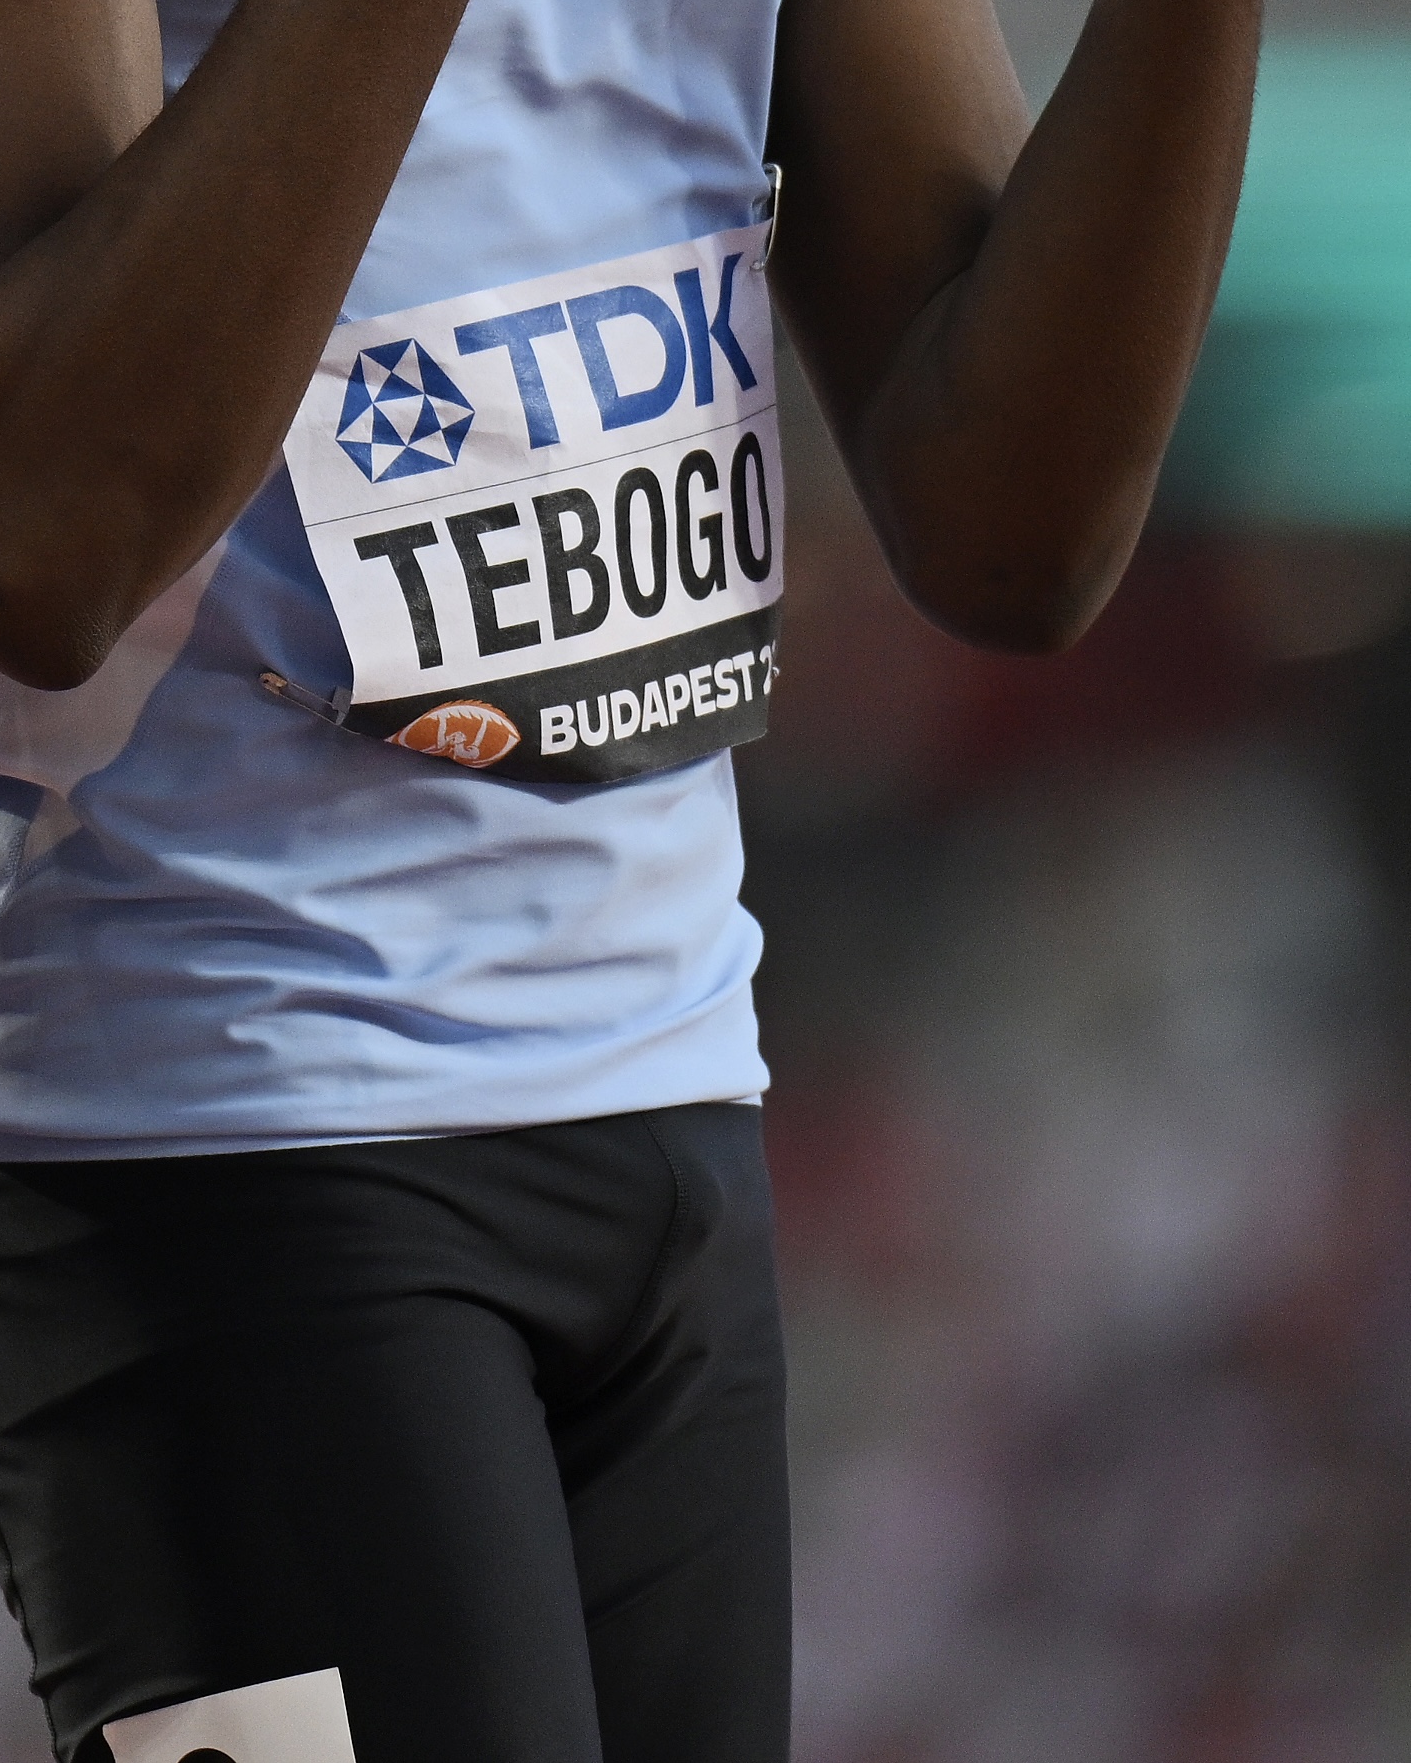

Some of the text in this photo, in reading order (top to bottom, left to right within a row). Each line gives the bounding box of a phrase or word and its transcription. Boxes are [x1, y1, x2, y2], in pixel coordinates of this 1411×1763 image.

[453, 253, 757, 449] TDK
[353, 432, 773, 670] TEBOGO
[540, 651, 755, 755] BUDAPEST
